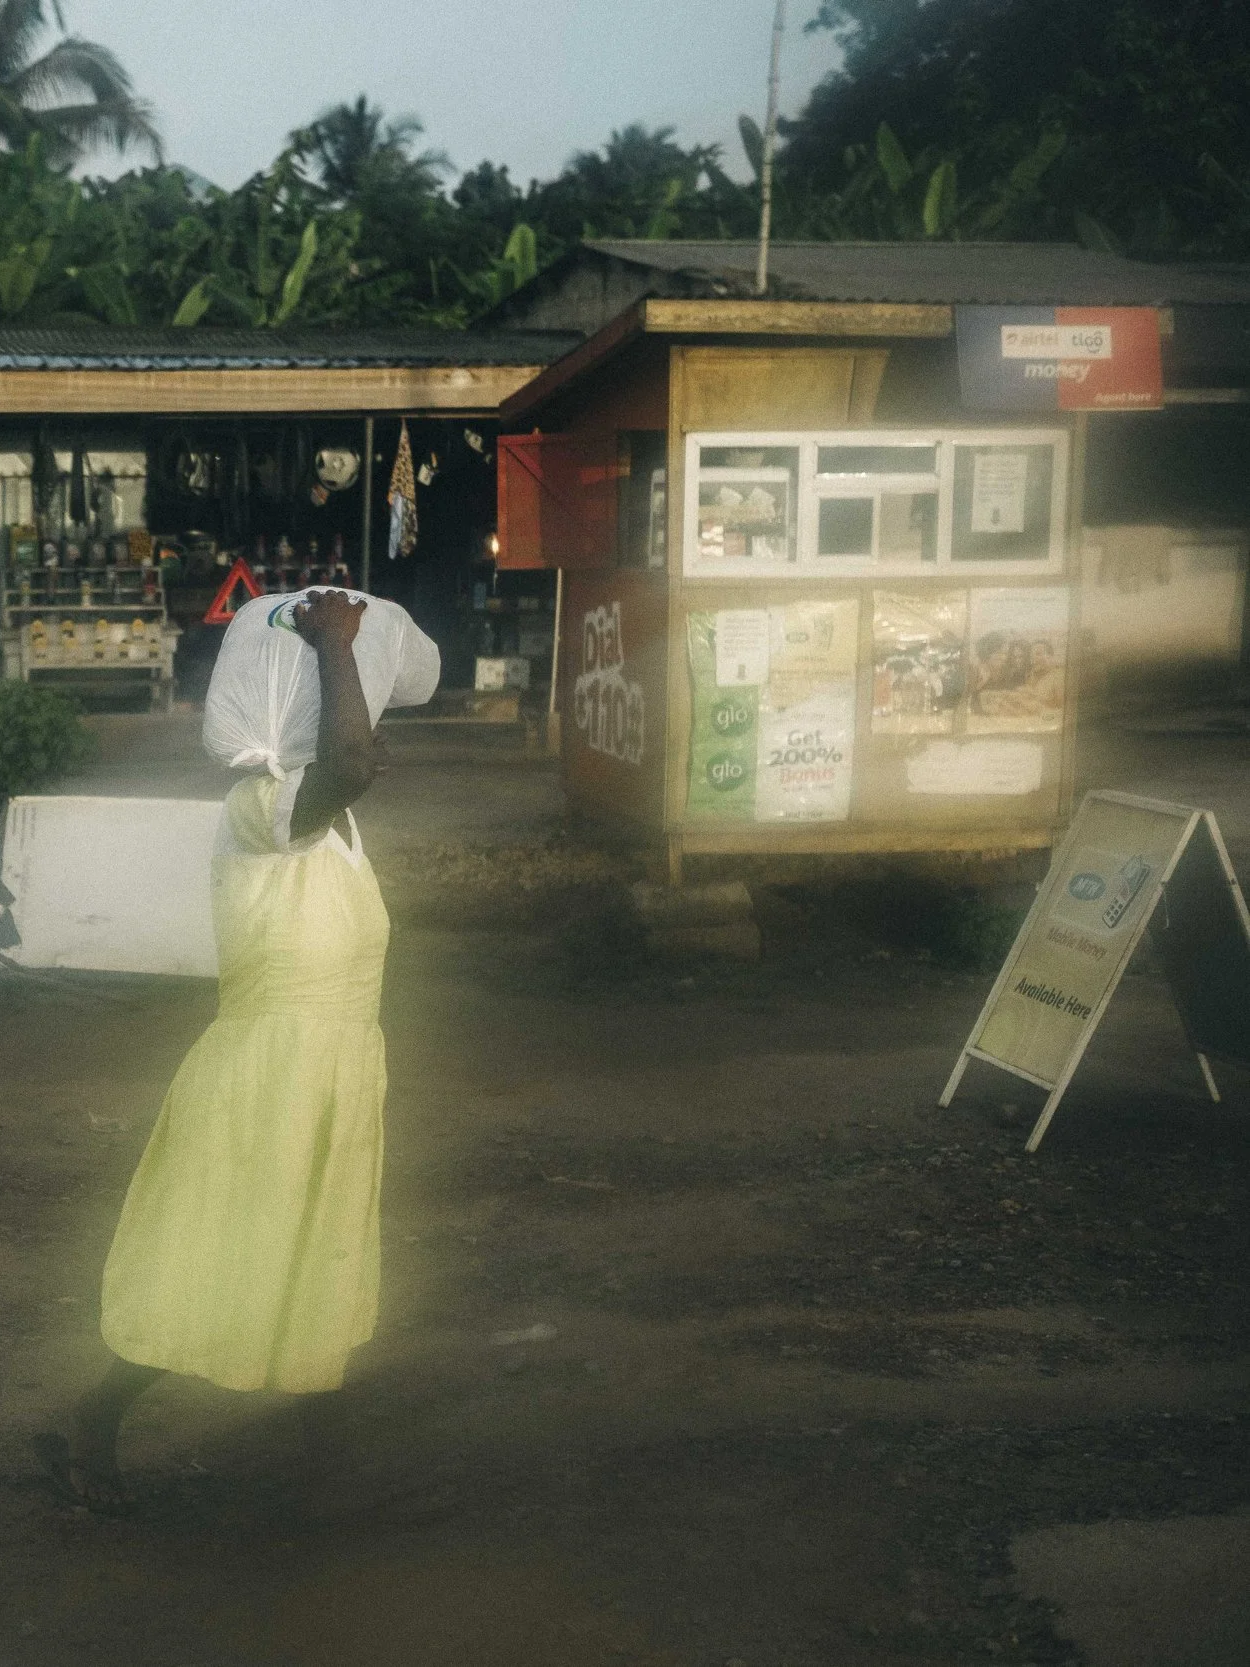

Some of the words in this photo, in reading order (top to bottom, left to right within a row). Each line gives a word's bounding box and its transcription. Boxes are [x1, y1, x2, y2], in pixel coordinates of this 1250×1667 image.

[1020, 332, 1059, 347] airtel
[1072, 331, 1103, 353] tigo
[1024, 363, 1091, 384] money
[717, 706, 748, 728] glo
[788, 729, 822, 747] Get
[768, 747, 843, 768] 200%
[712, 761, 742, 782] glo
[779, 766, 834, 785] Bonus
[1014, 977, 1066, 1010] Available
[1063, 994, 1093, 1020] Here
